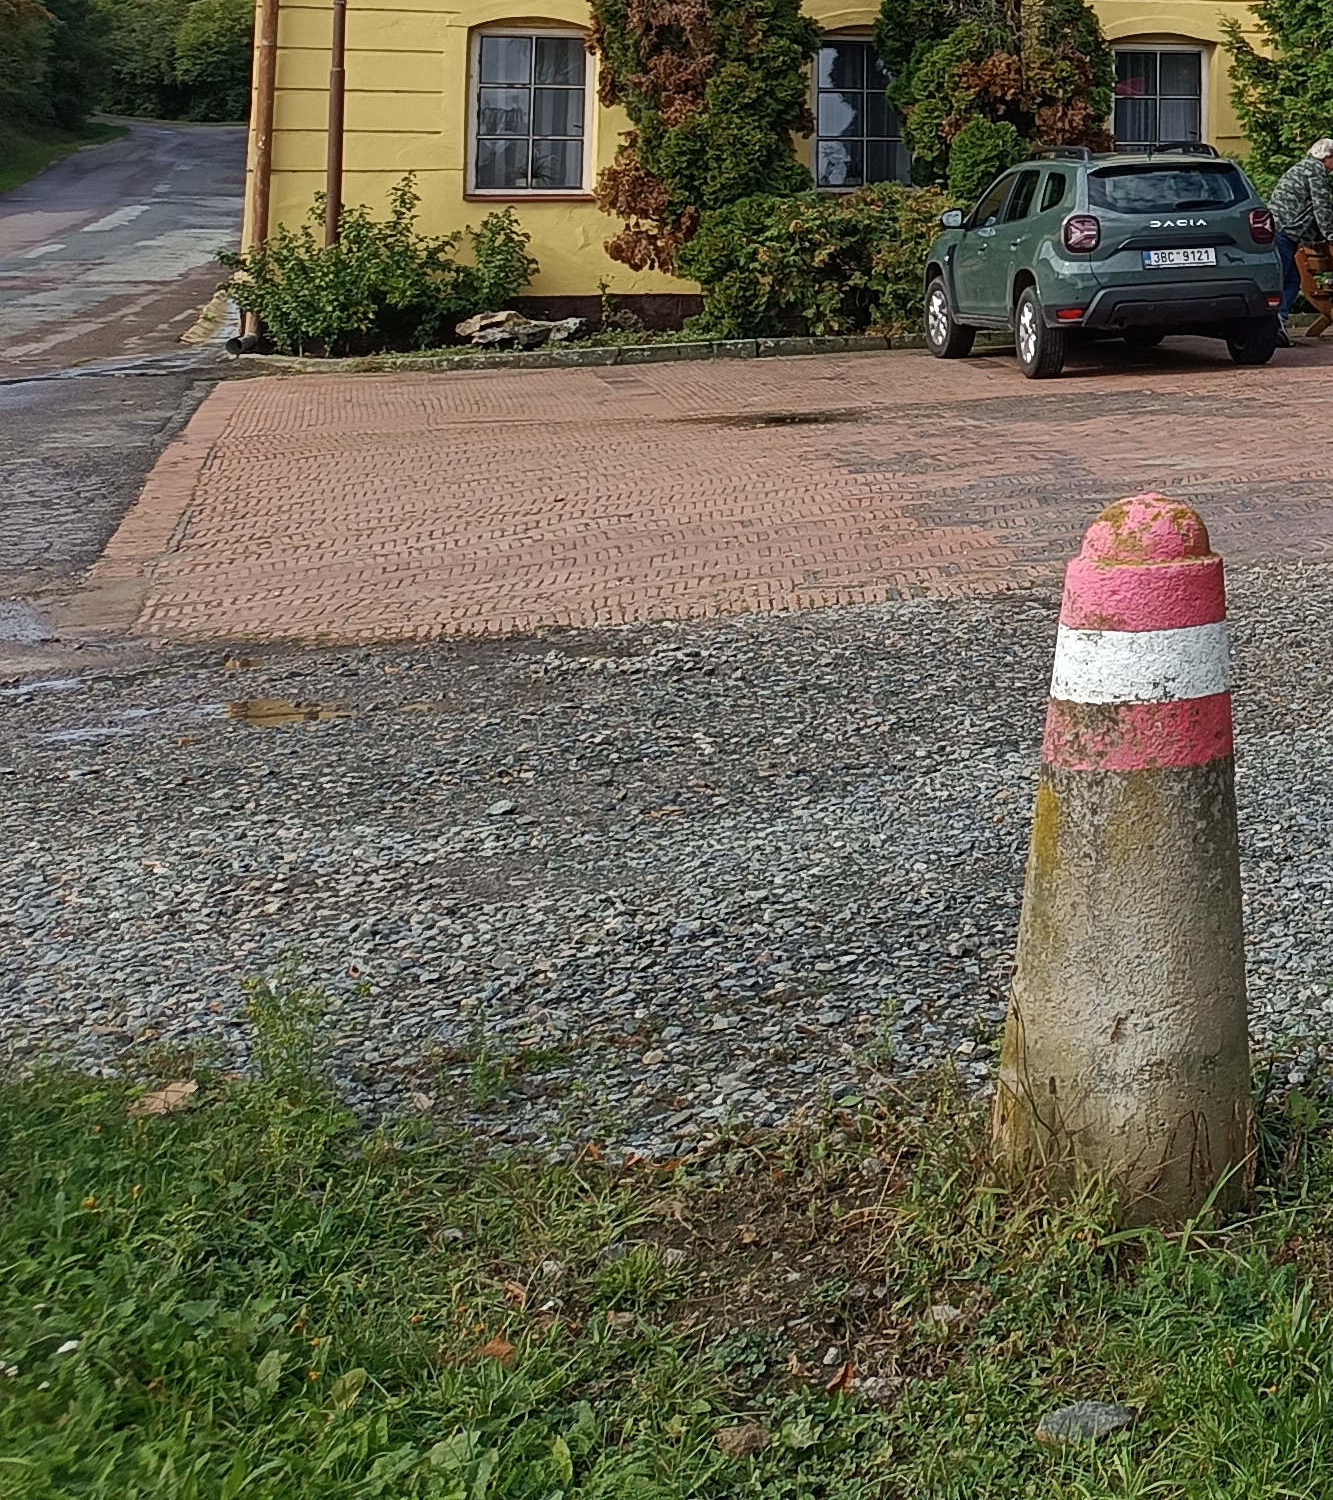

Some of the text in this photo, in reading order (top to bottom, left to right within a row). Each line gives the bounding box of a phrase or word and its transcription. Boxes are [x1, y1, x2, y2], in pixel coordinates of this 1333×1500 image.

[1150, 219, 1208, 228] DACIA
[1153, 250, 1211, 264] 3BC 9121
